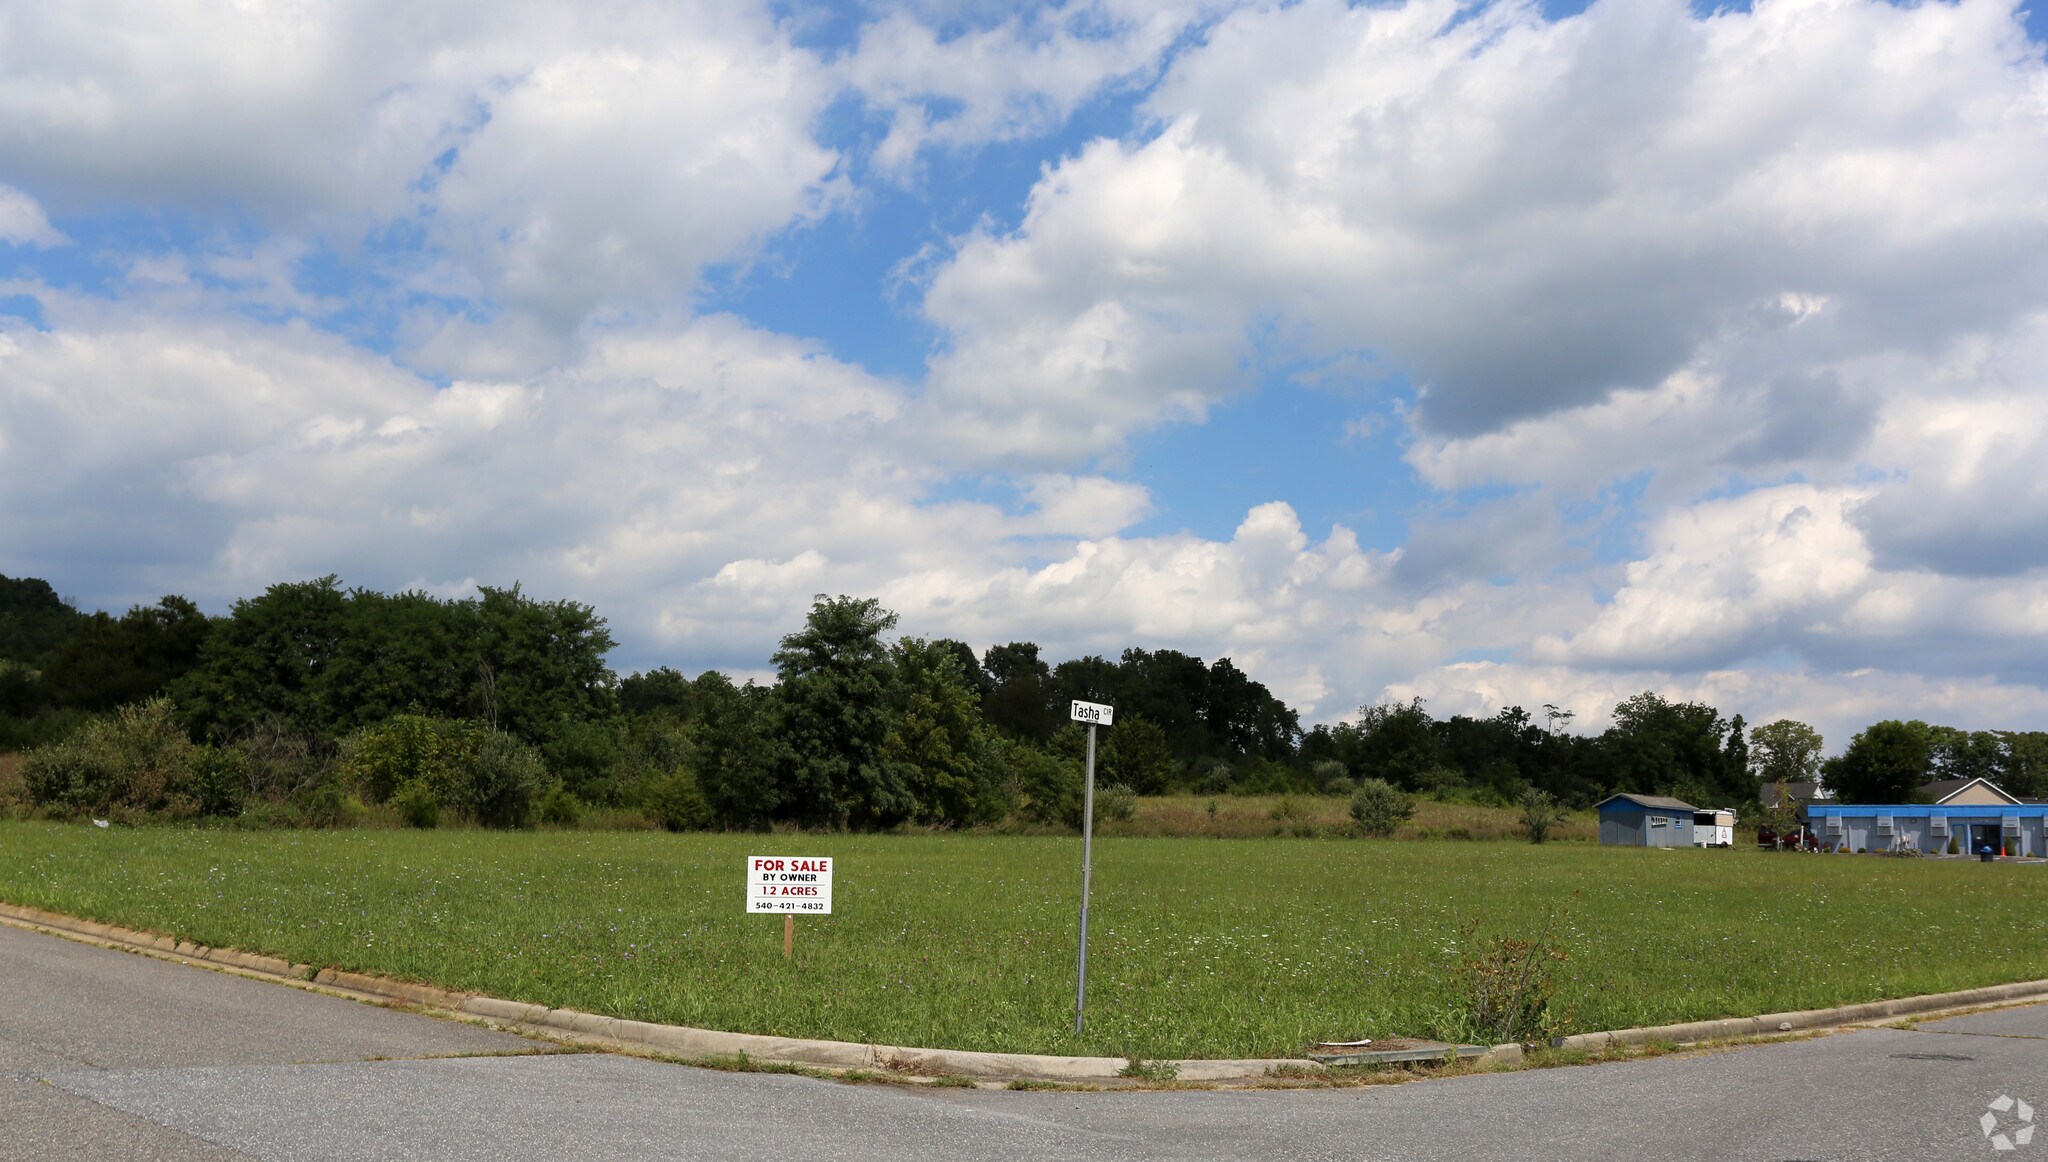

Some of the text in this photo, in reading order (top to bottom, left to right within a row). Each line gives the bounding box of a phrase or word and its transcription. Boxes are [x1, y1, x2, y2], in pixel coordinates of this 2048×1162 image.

[1074, 703, 1099, 720] Tasha
[755, 860, 827, 872] FOR SALE
[763, 873, 816, 881] BY OWNER
[763, 886, 817, 896] 1.2 ACRES
[755, 902, 823, 910] 540-421-4832
